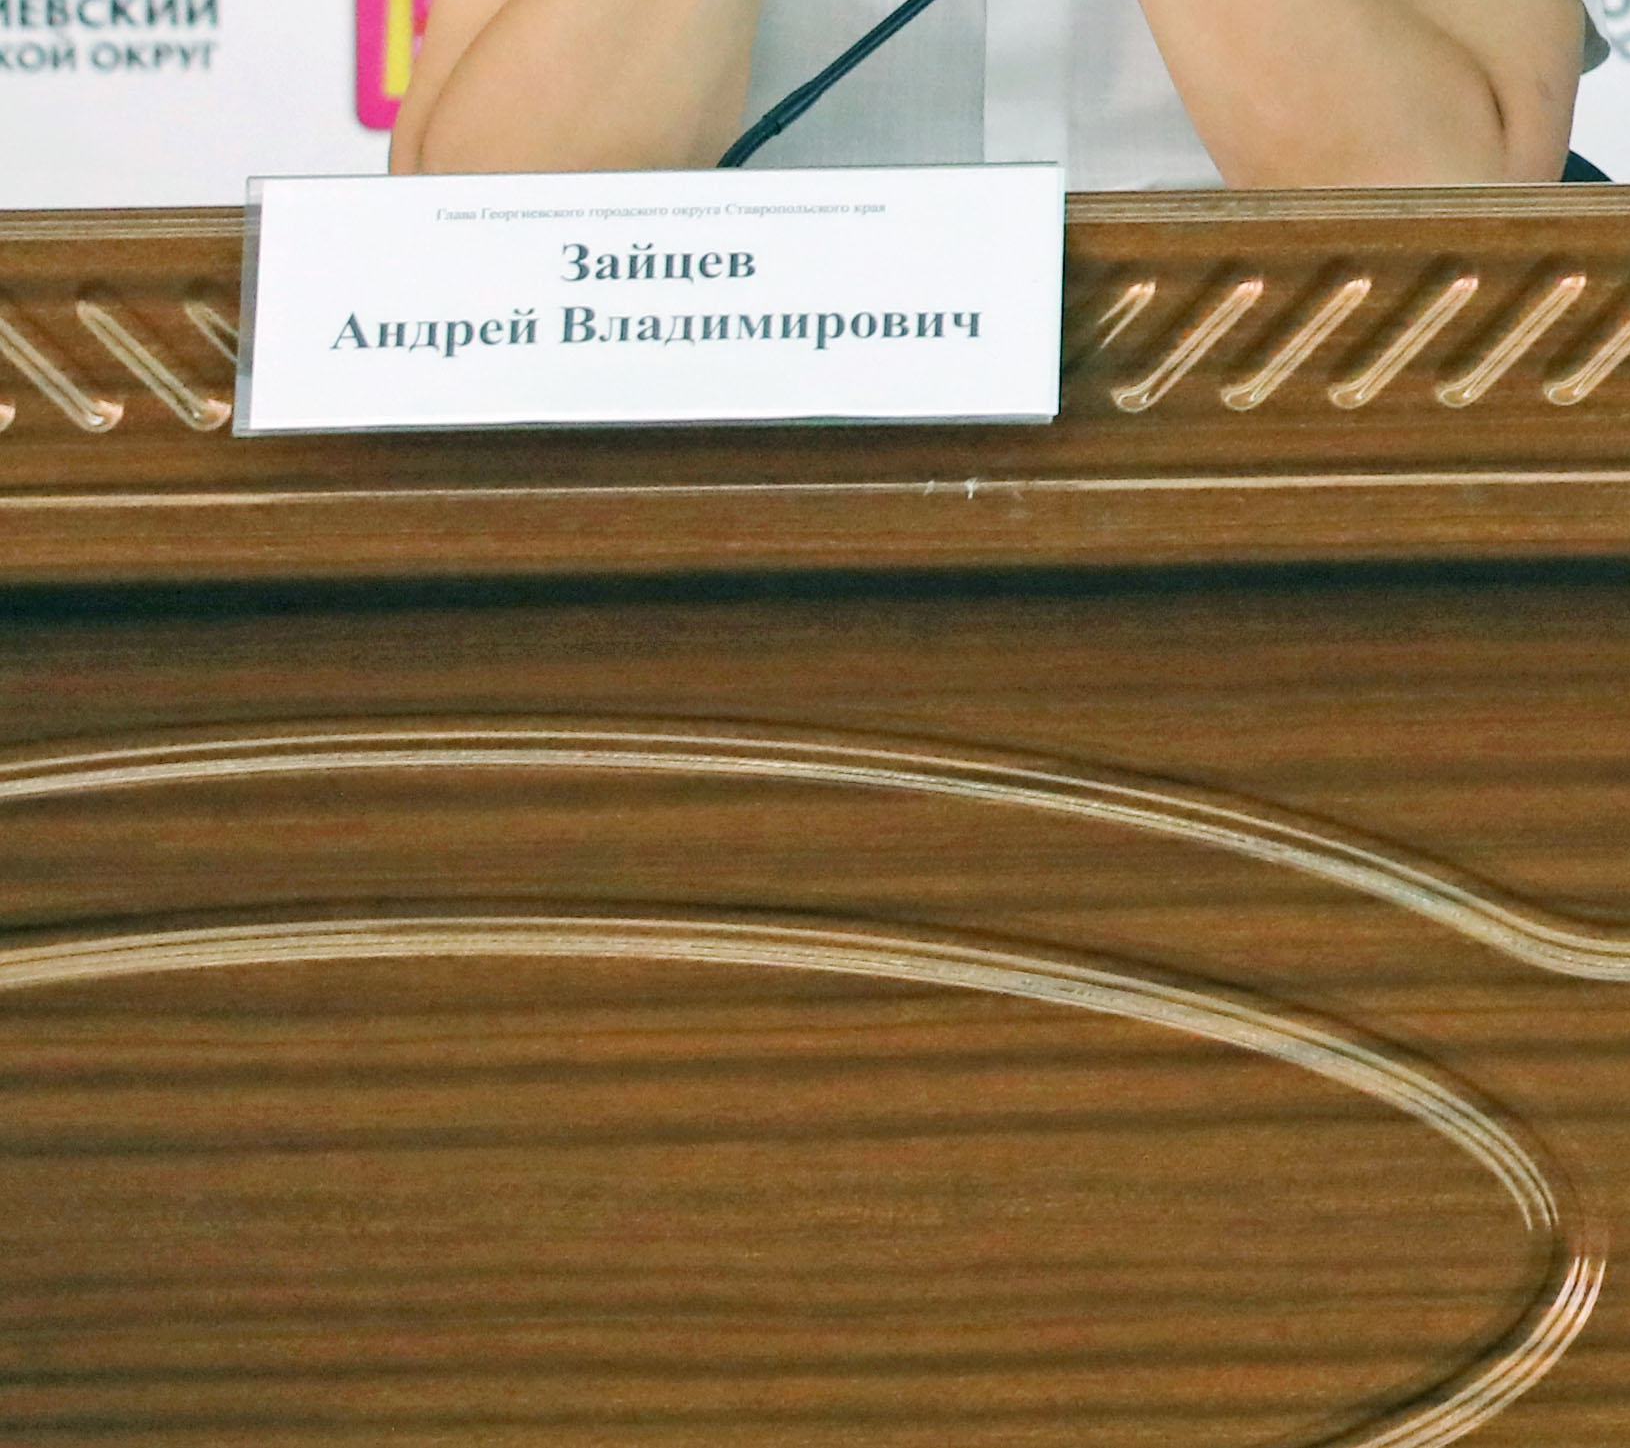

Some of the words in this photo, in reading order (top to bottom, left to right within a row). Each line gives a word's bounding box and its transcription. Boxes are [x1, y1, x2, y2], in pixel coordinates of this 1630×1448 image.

[89, 41, 215, 72] ОКРУГ
[436, 207, 478, 223] Глава
[481, 204, 586, 223] Георгиевского
[588, 204, 671, 221] городского
[673, 203, 723, 221] округа
[725, 200, 852, 219] Ставропольского
[854, 201, 888, 217] края
[560, 243, 757, 285] Зайцев
[331, 305, 540, 359] Андрей
[561, 302, 982, 352] Владимирович
